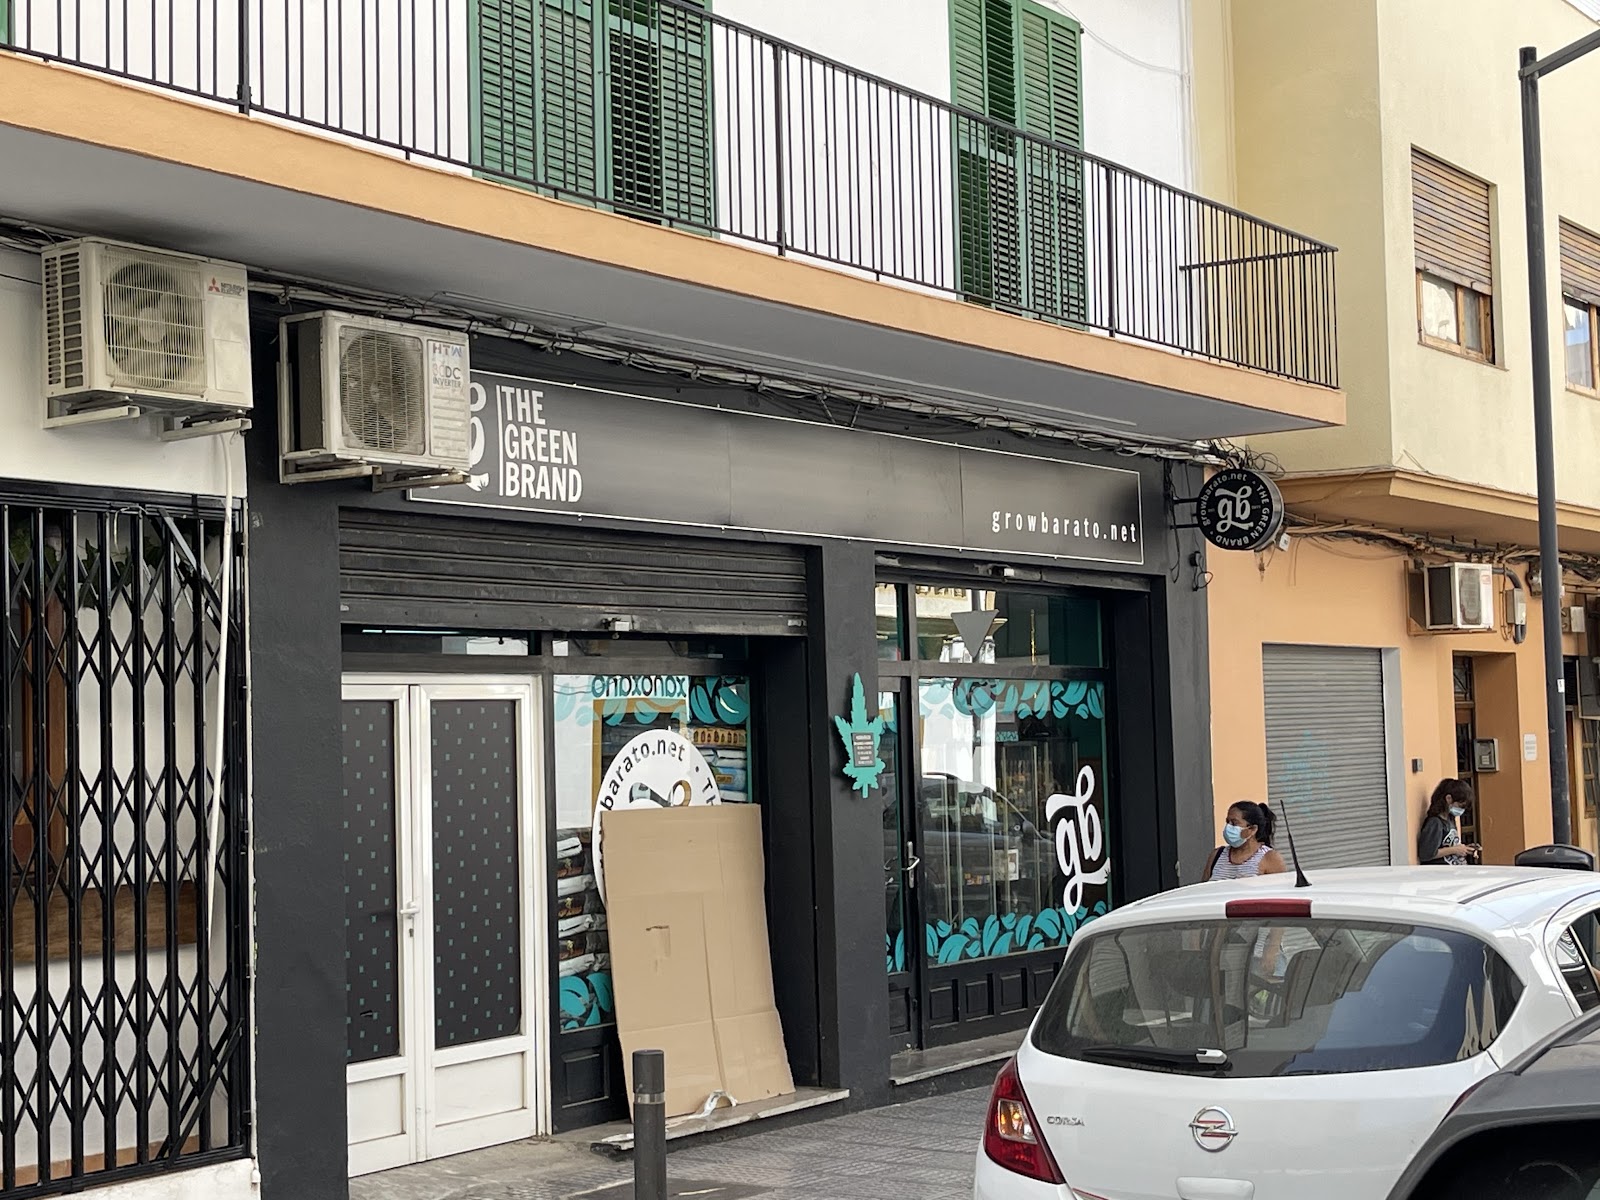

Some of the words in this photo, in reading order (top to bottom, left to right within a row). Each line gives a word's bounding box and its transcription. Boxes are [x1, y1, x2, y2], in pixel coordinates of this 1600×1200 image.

[432, 343, 463, 357] HTW
[501, 385, 546, 425] THE
[504, 423, 578, 466] GREEN
[505, 461, 583, 502] BRAND
[1200, 473, 1248, 527] growbarato.net
[1256, 484, 1269, 505] THE
[991, 510, 1137, 543] growbarato.net
[1214, 485, 1254, 533] gb
[1250, 507, 1270, 539] GREEN
[1215, 534, 1250, 547] BRAND
[599, 737, 686, 822] barato.net
